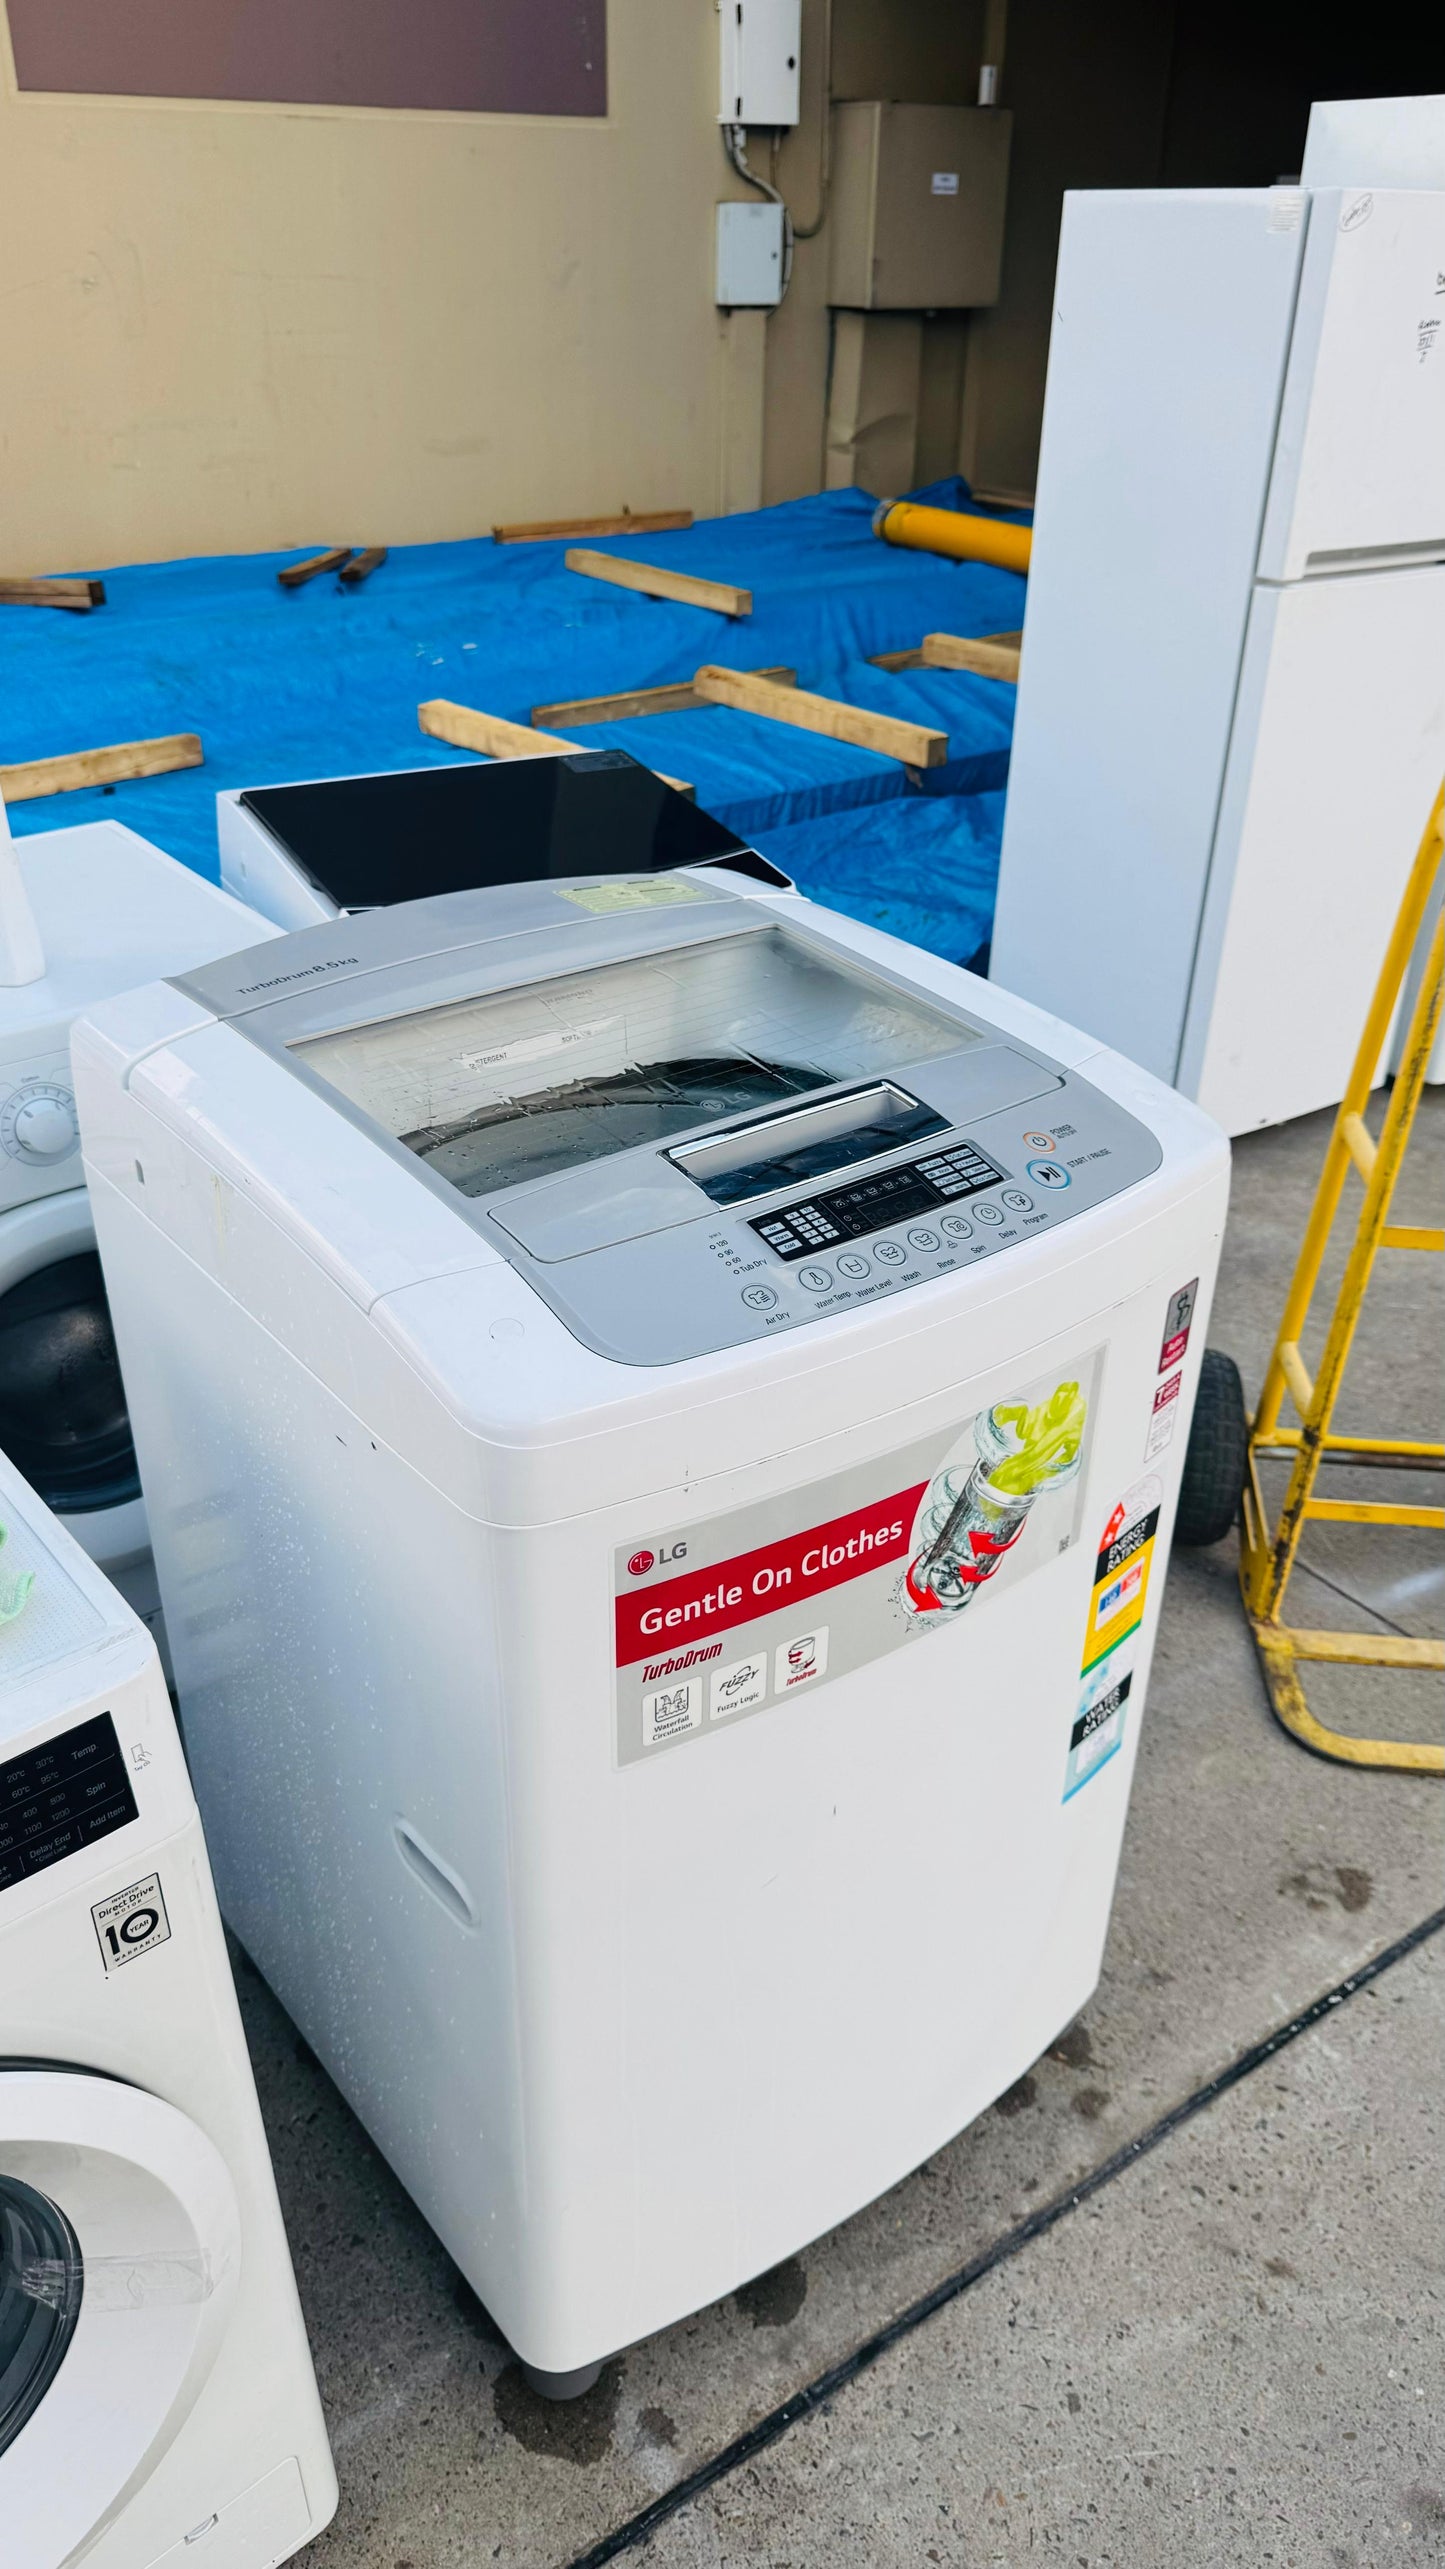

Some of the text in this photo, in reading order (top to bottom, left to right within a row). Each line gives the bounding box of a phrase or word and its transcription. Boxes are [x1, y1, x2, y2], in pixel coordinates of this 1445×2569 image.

[236, 969, 314, 995] TurboDrum
[722, 1091, 752, 1104] LG
[1066, 1156, 1088, 1168] START
[1090, 1148, 1112, 1160] PAUSE
[1022, 1213, 1049, 1226] Program
[773, 1232, 789, 1241] Warm
[998, 1229, 1018, 1240] Delay
[717, 1240, 729, 1248] 120
[784, 1242, 796, 1250] Cold
[970, 1245, 987, 1254] Spin
[740, 1258, 768, 1273] Tub Dry
[937, 1258, 956, 1269] Rinse
[901, 1270, 921, 1282] Wash
[856, 1279, 893, 1298] Water Level
[814, 1298, 833, 1309] Water
[765, 1311, 790, 1325] Air Dry
[1108, 1518, 1148, 1560] ENERGY
[659, 1542, 688, 1565] LG
[1107, 1533, 1146, 1573] RATING
[639, 1520, 903, 1635] Gentle On Clothes
[642, 1643, 723, 1683] TurboDrum
[786, 1668, 817, 1686] TurboDrum
[717, 1691, 759, 1713] Fuzzy Logic
[1085, 1686, 1120, 1723] WATER
[654, 1715, 690, 1733] Waterfall
[1082, 1697, 1119, 1737] RATING
[652, 1722, 693, 1741] Circulation
[86, 1782, 106, 1796] Spin
[24, 1822, 42, 1835] 1100
[52, 1807, 70, 1821] 1200
[89, 1805, 126, 1829] Add Item
[29, 1832, 72, 1859] Delay End
[98, 1885, 154, 1919] Direct Drive
[111, 1886, 139, 1903] INVERTER
[114, 1899, 142, 1916] MOTOR
[105, 1908, 159, 1956] 10
[129, 1919, 149, 1933] YEAR
[114, 1934, 161, 1962] WARRANTY
